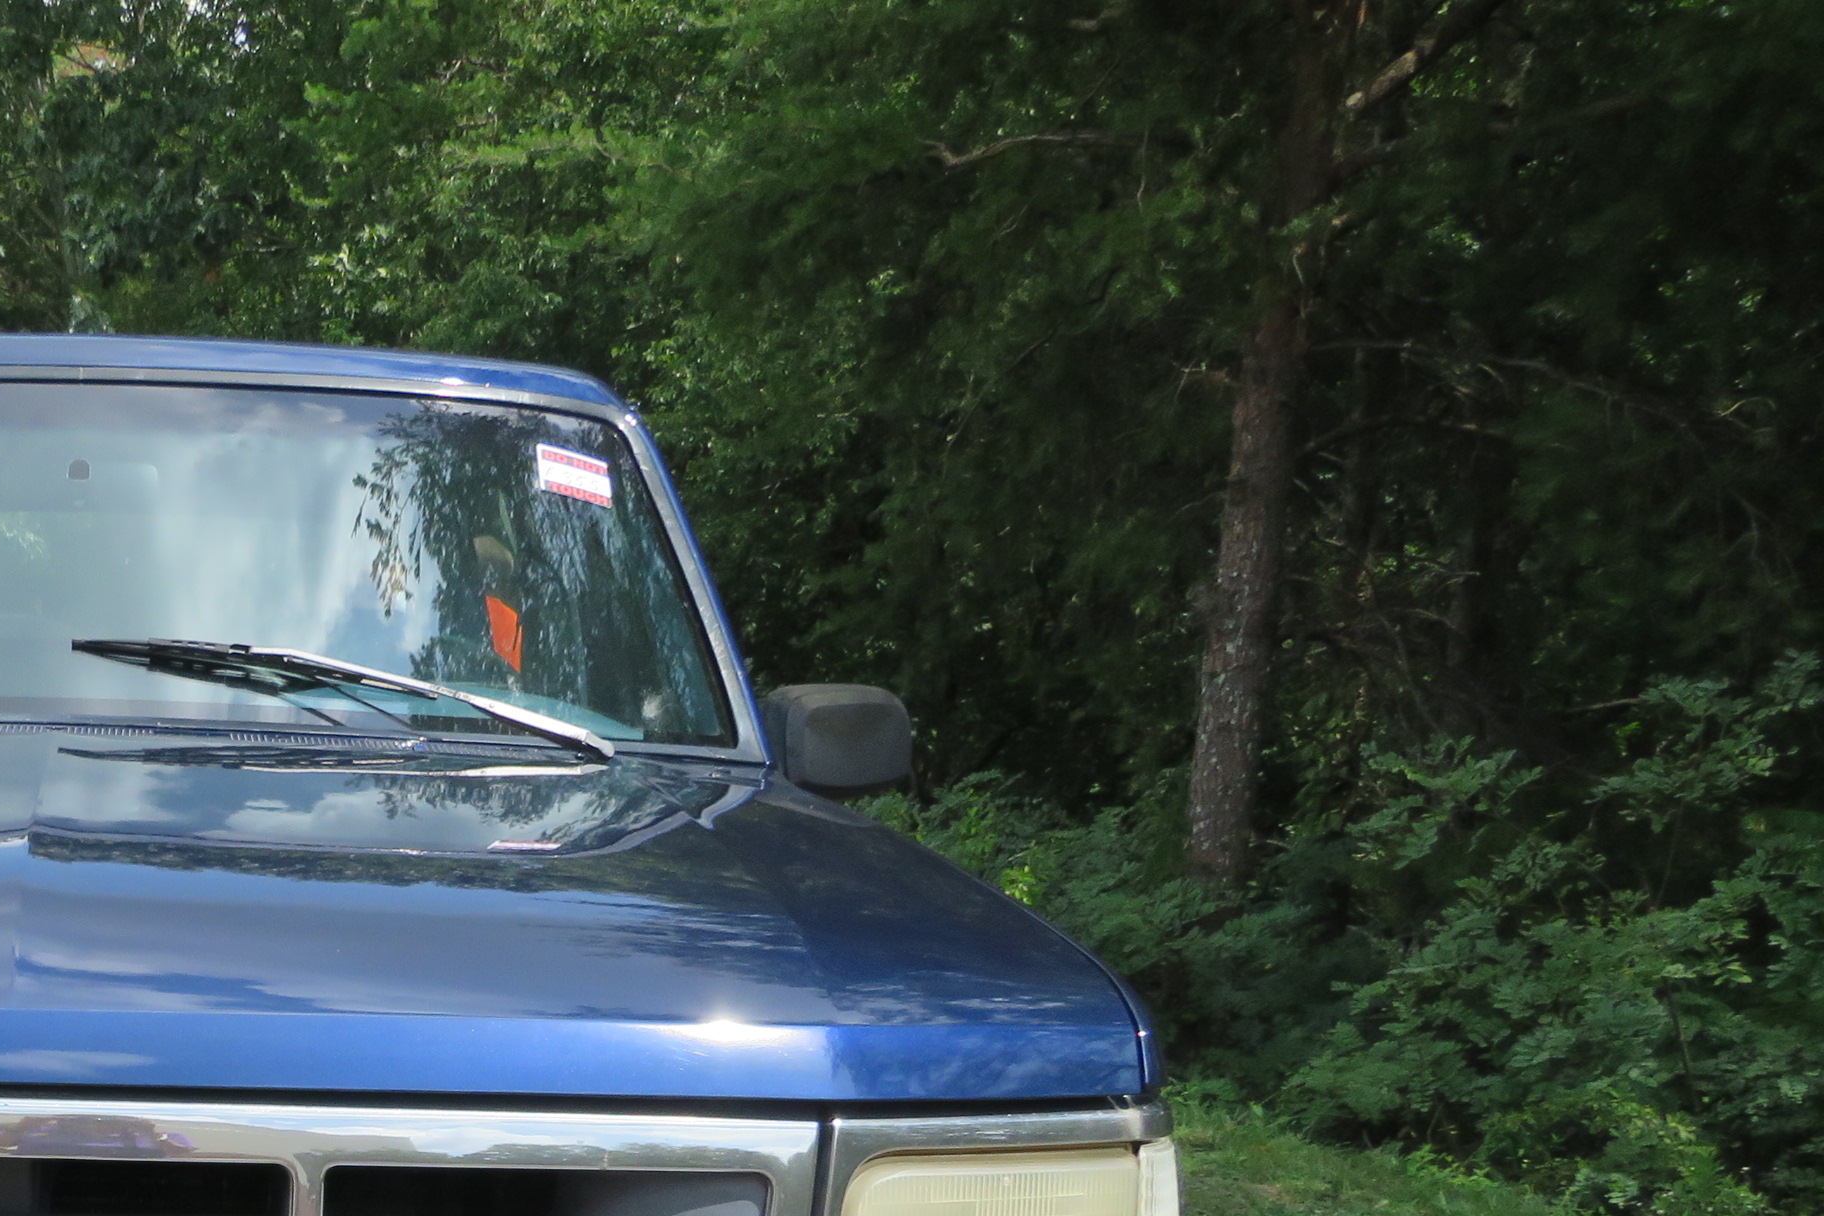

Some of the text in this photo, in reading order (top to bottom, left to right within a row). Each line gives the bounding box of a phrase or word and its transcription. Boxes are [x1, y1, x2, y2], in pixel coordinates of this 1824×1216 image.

[543, 449, 607, 476] DO NOT
[548, 481, 608, 506] TOUCH
